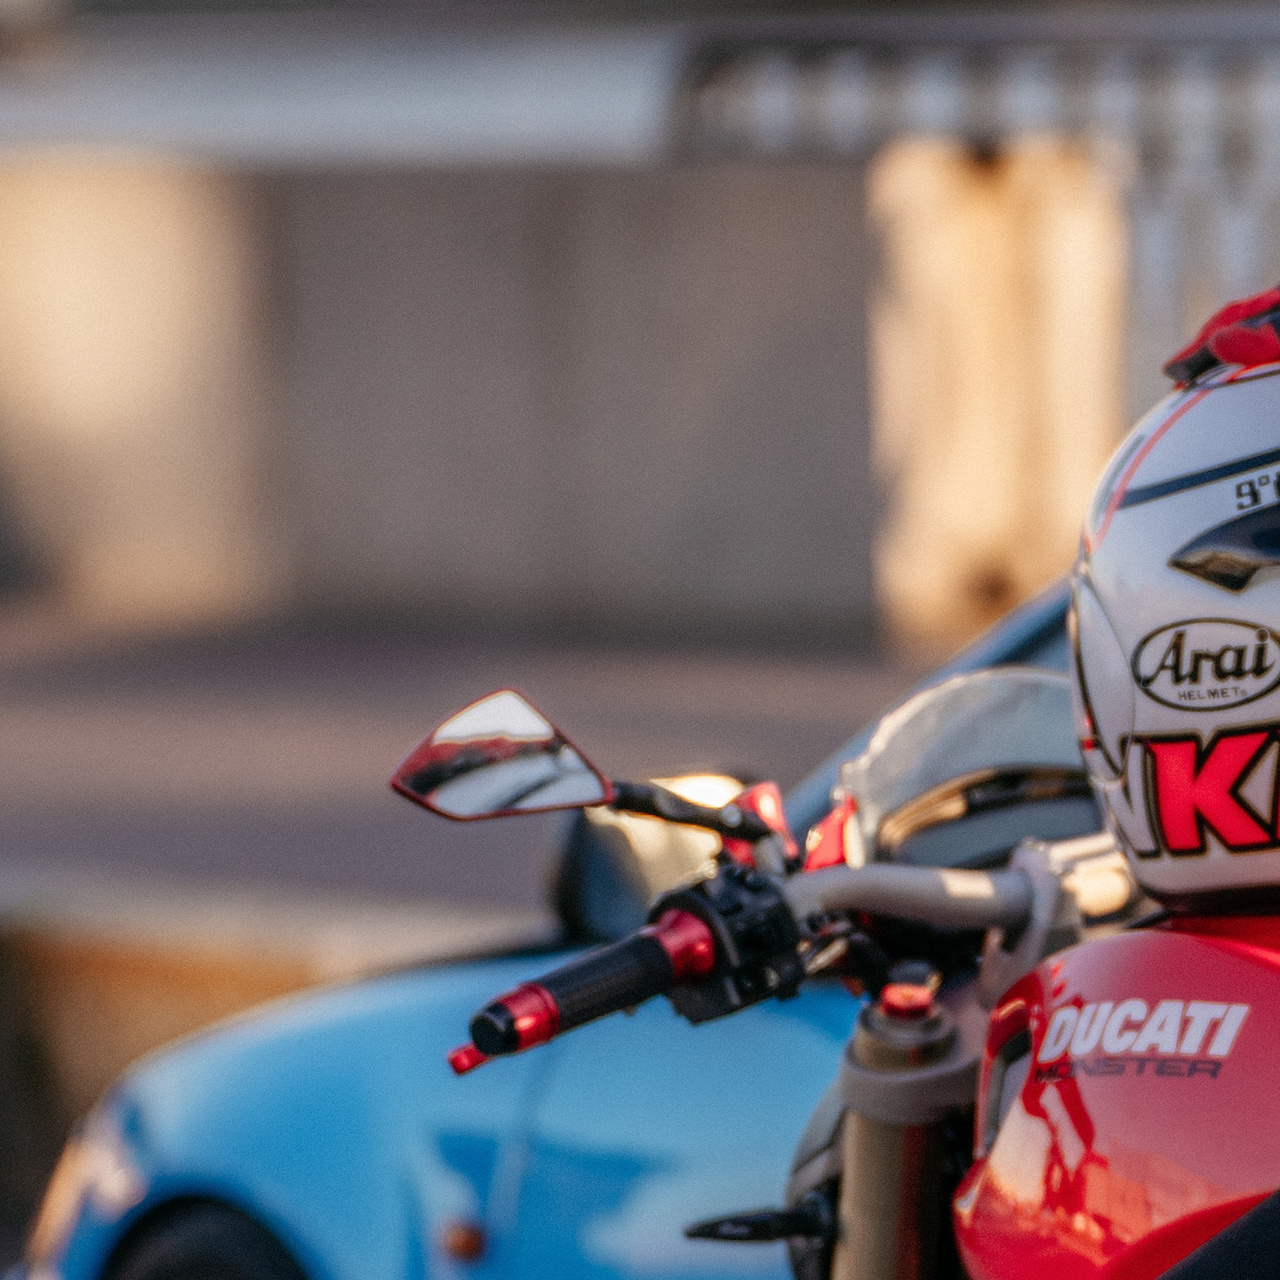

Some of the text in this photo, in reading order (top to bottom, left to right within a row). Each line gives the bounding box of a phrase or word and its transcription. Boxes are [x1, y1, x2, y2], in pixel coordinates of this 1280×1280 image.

[1141, 628, 1275, 686] Arai
[1036, 997, 1251, 1065] DUCATI
[1033, 1056, 1223, 1082] MONSTER
